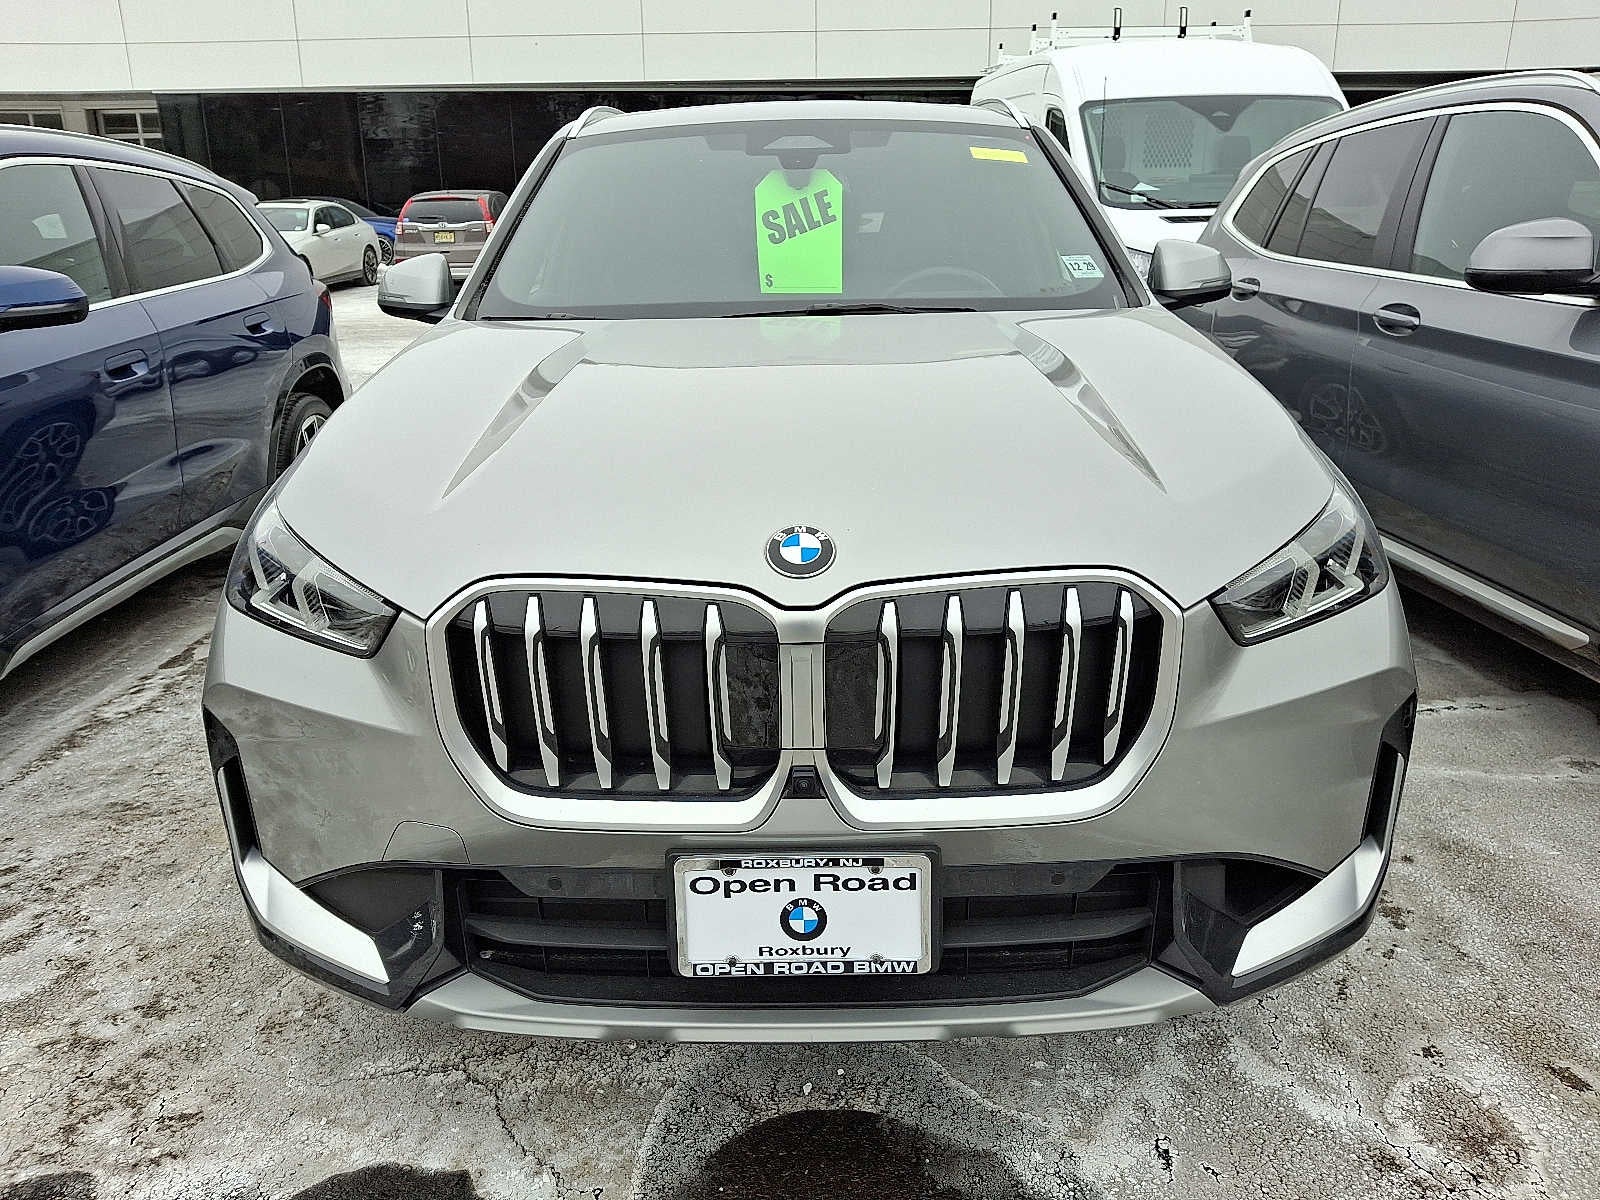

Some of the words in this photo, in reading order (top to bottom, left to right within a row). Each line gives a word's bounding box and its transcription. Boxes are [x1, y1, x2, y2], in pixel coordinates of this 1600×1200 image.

[761, 189, 837, 245] SALE
[1069, 262, 1083, 271] 12
[765, 273, 773, 288] $
[773, 526, 830, 542] BMW
[839, 858, 863, 867] NJ
[689, 876, 796, 899] Open
[813, 873, 917, 892] Road
[785, 899, 822, 912] BMW
[758, 945, 851, 957] Roxbury
[695, 963, 765, 976] OPEN
[773, 961, 845, 976] ROAD
[853, 961, 916, 974] BMW
